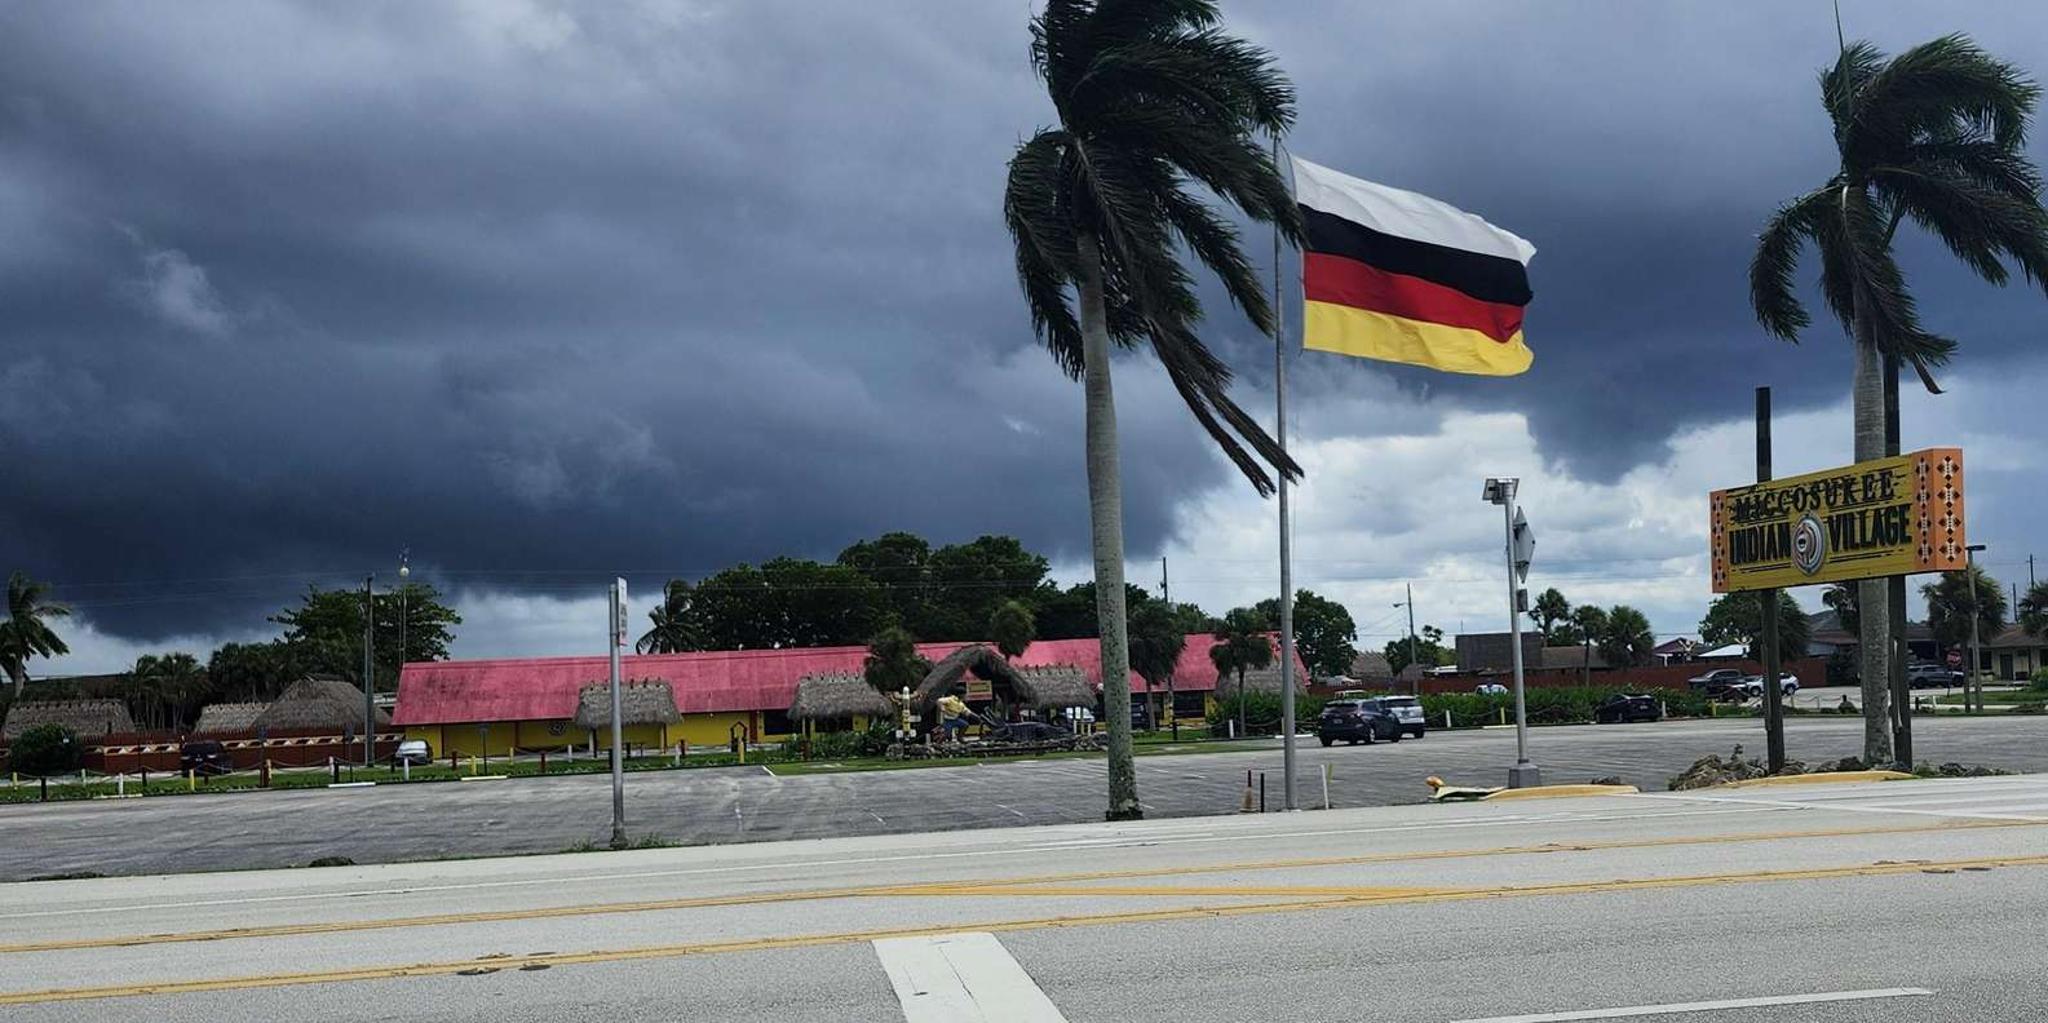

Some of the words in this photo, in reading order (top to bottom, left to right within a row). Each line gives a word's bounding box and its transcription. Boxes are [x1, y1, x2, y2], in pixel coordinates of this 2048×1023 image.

[1734, 470, 1894, 520] MICCOSUKEE
[1729, 522, 1792, 565] INDIAN
[1826, 503, 1912, 552] VILLAGE
